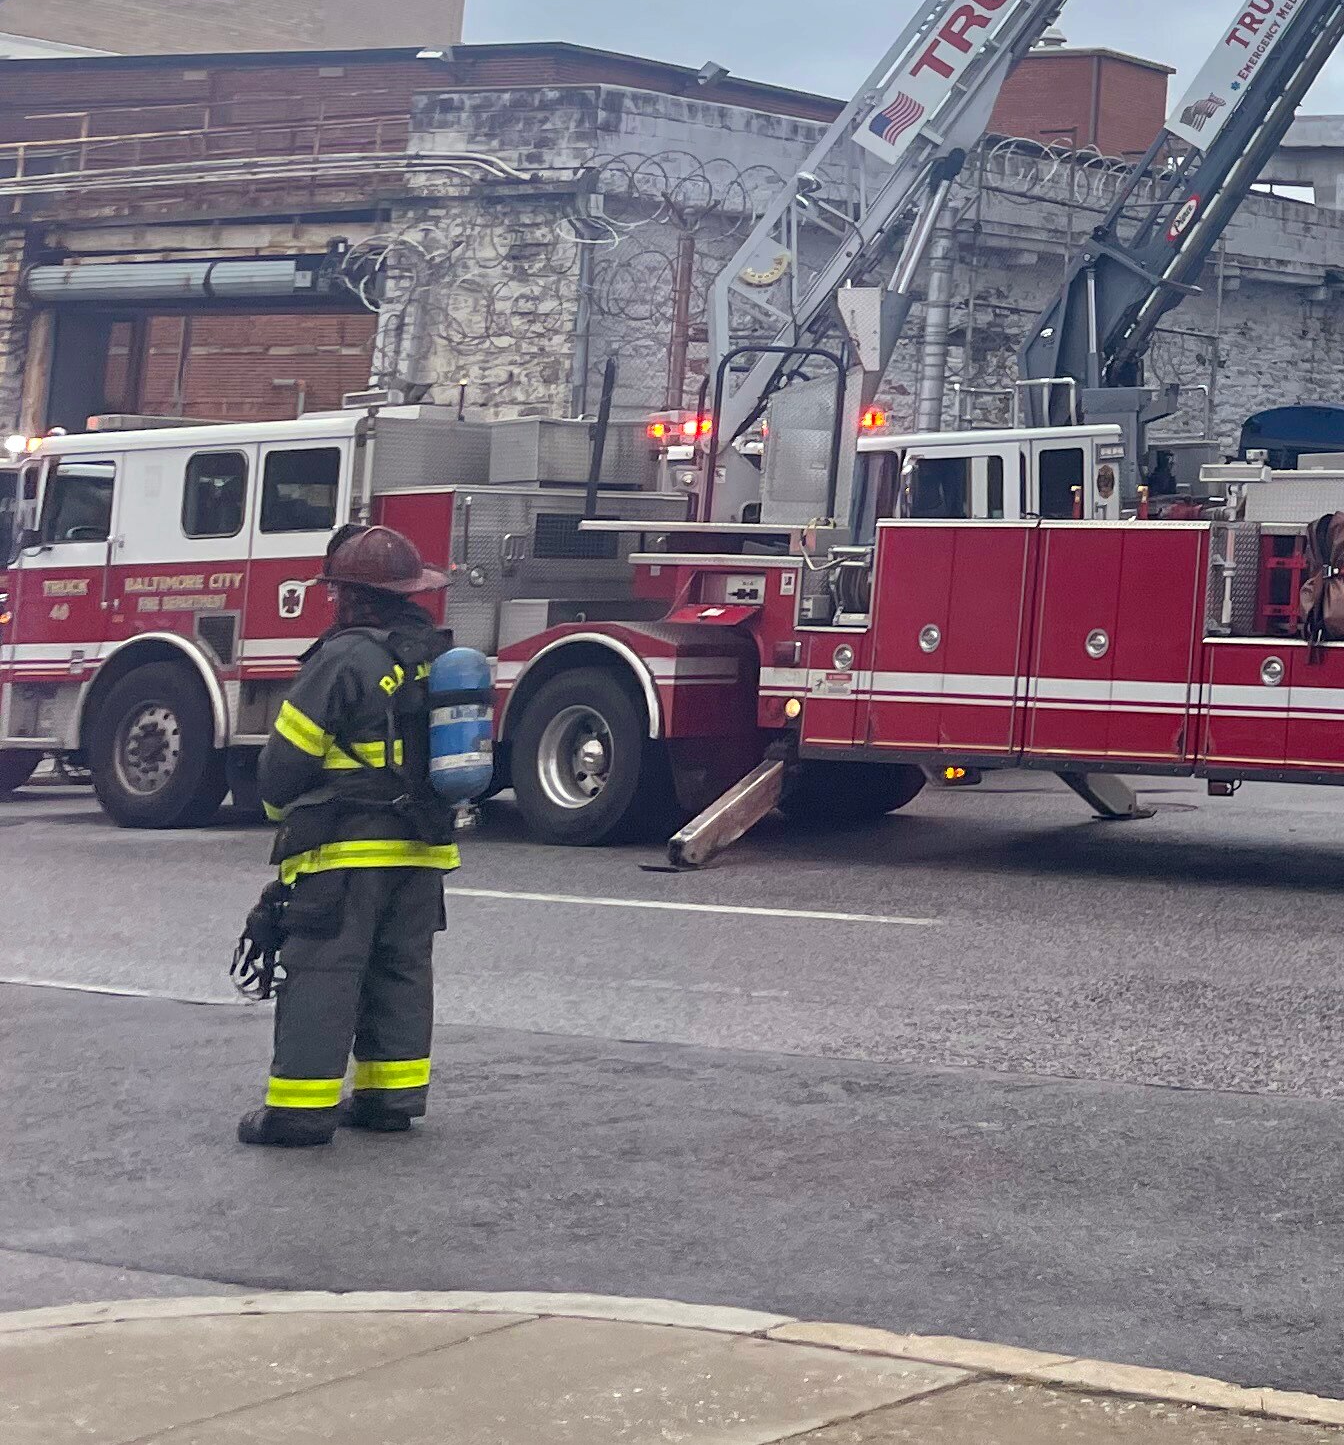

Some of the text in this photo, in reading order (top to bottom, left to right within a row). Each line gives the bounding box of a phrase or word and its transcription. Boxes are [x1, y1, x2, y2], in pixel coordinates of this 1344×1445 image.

[1237, 19, 1281, 81] EMERGENCY
[43, 578, 90, 597] TRUCK
[124, 572, 243, 594] BALTIMORE CITY
